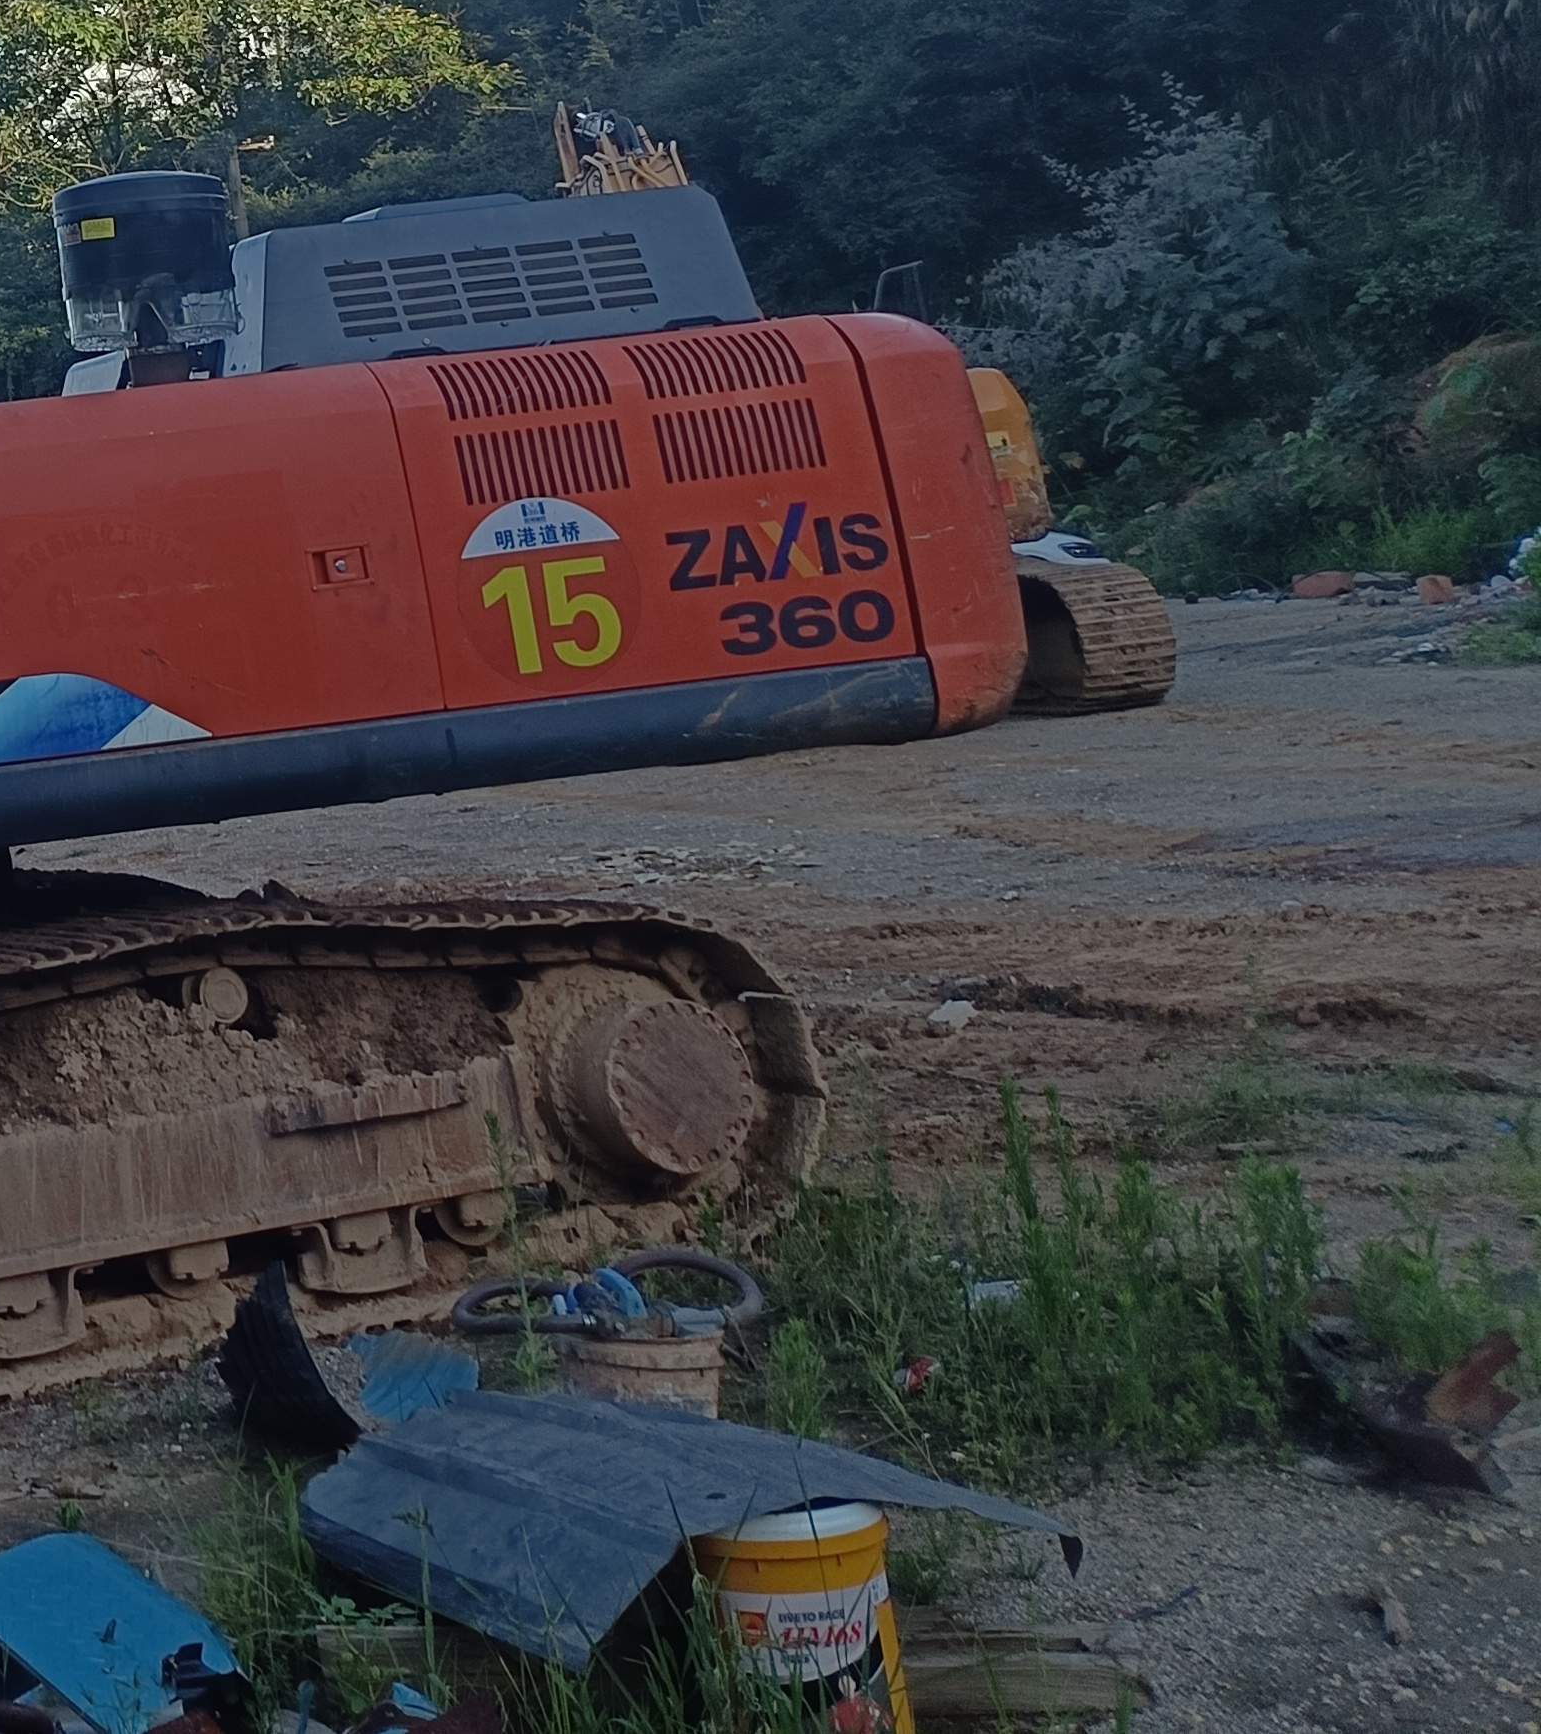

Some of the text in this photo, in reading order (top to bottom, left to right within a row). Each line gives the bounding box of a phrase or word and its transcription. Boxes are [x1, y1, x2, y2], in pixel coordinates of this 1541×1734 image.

[494, 521, 581, 550] 明港道桥
[665, 501, 889, 592] ZAXIS
[481, 555, 623, 675] 15
[720, 589, 896, 656] 360
